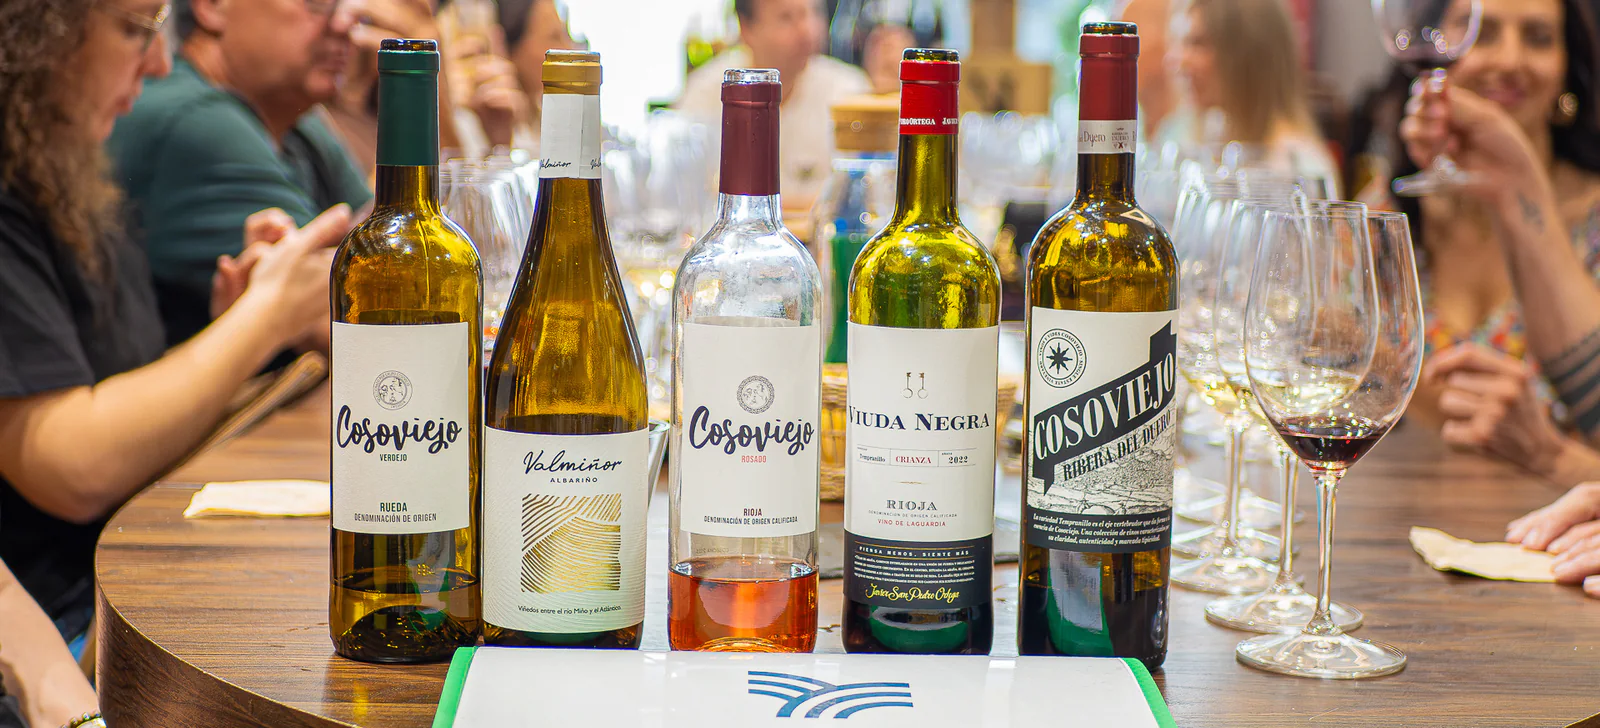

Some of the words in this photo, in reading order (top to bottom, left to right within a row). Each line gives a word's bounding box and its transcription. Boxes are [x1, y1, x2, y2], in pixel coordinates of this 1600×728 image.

[1034, 352, 1174, 460] COSOVIEJO
[849, 405, 906, 430] VIUDA
[914, 413, 990, 431] NEGRA
[337, 405, 462, 454] Cosoviejo
[689, 405, 814, 455] Cosoviejo
[1063, 446, 1116, 481] RIBERA
[1117, 434, 1140, 458] DEL
[1142, 409, 1171, 446] DUERO
[380, 454, 407, 462] VERDEJO
[524, 450, 622, 474] Valmiñor
[742, 455, 767, 463] ROSADO
[896, 456, 932, 464] CRIANZA
[948, 456, 968, 464] 2022
[380, 502, 408, 512] RUEDA
[886, 500, 937, 511] RIOJA
[743, 508, 762, 516] RIOJA
[354, 513, 400, 522] DENOMINACIÓN
[402, 514, 411, 522] DE
[413, 513, 437, 522] ORIGEN
[704, 515, 742, 524] DENOMINACIÓN
[772, 515, 798, 524] CALIFICADA
[1059, 517, 1091, 526] Tempranillo
[888, 586, 908, 600] San
[905, 586, 934, 602] Pedro
[935, 587, 960, 603] Ortega
